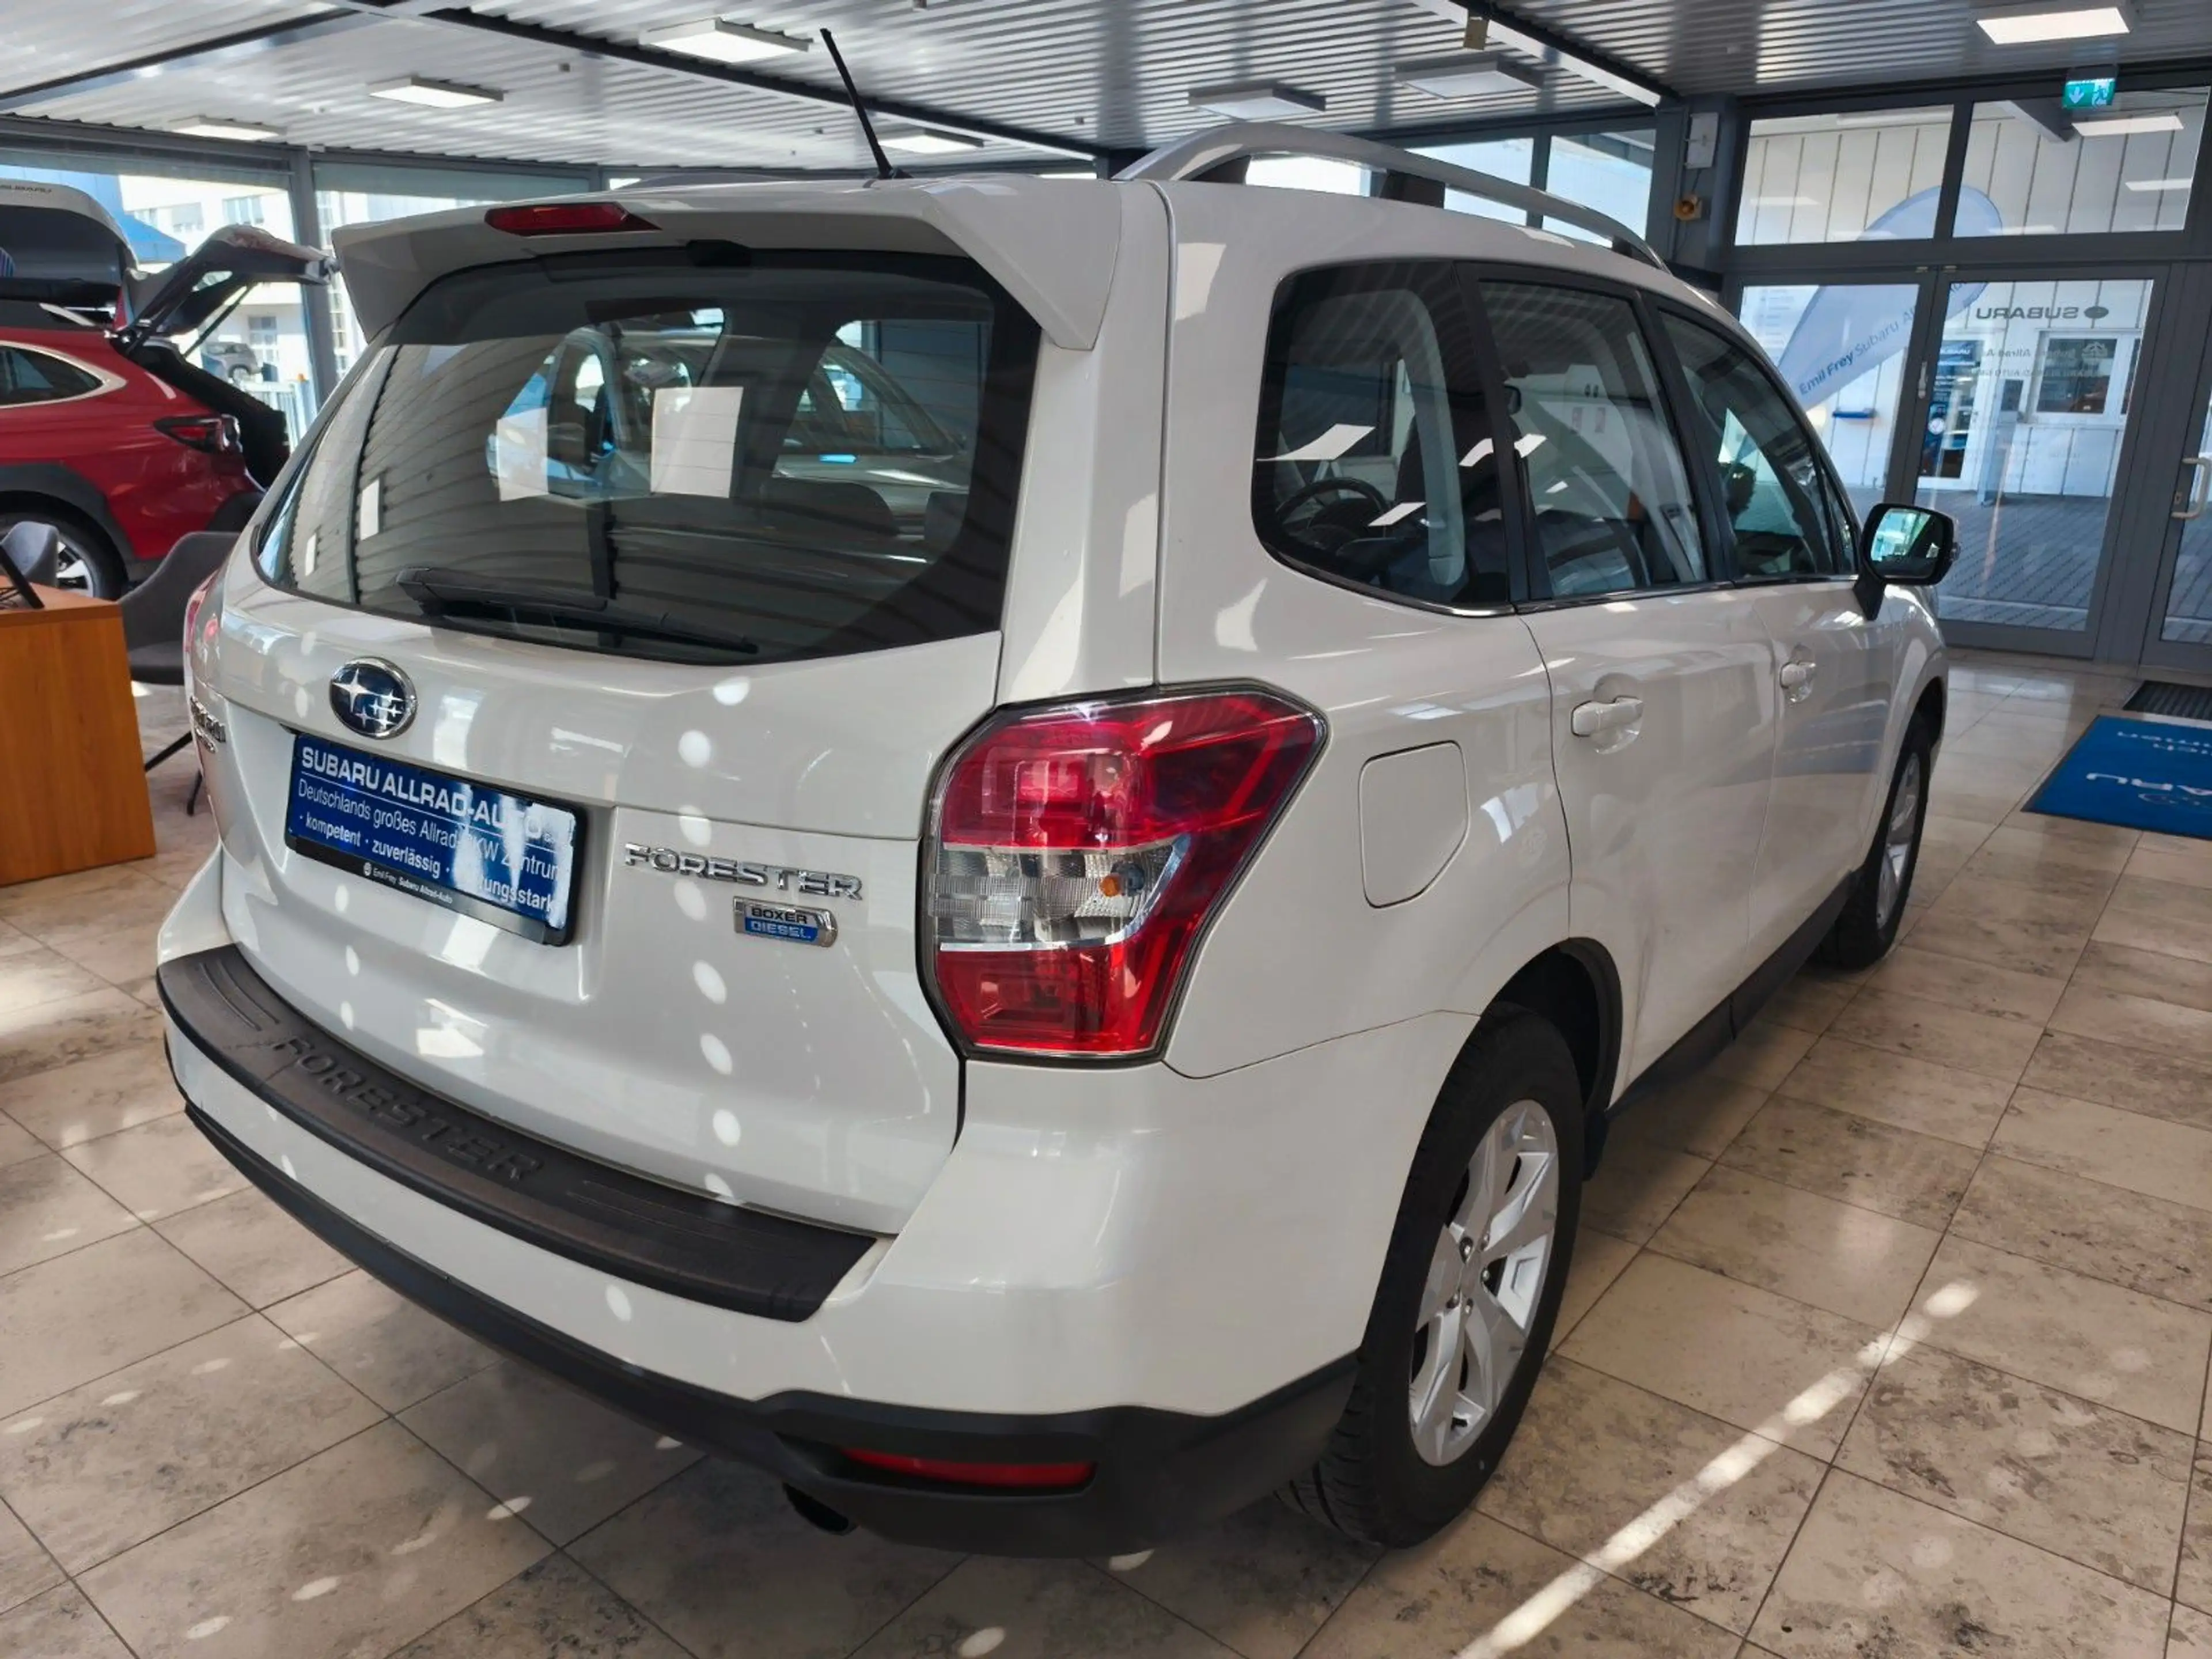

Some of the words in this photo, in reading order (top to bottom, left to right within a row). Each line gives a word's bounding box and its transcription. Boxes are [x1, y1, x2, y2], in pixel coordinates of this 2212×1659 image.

[1799, 368, 1827, 394] Emil
[1828, 351, 1854, 380] Frey
[1855, 320, 1899, 357] Subaru
[298, 779, 372, 820] Deutschlands
[374, 809, 416, 835] großes
[302, 747, 380, 790] SUBARU
[382, 772, 541, 839] ALLRAD-AUO
[305, 812, 361, 847] kompetent
[372, 839, 441, 879] zuverlässig
[624, 842, 863, 900] FORESTER
[751, 907, 808, 924] BOXER
[751, 920, 812, 939] DIESEL
[274, 1036, 544, 1179] FORESTER
